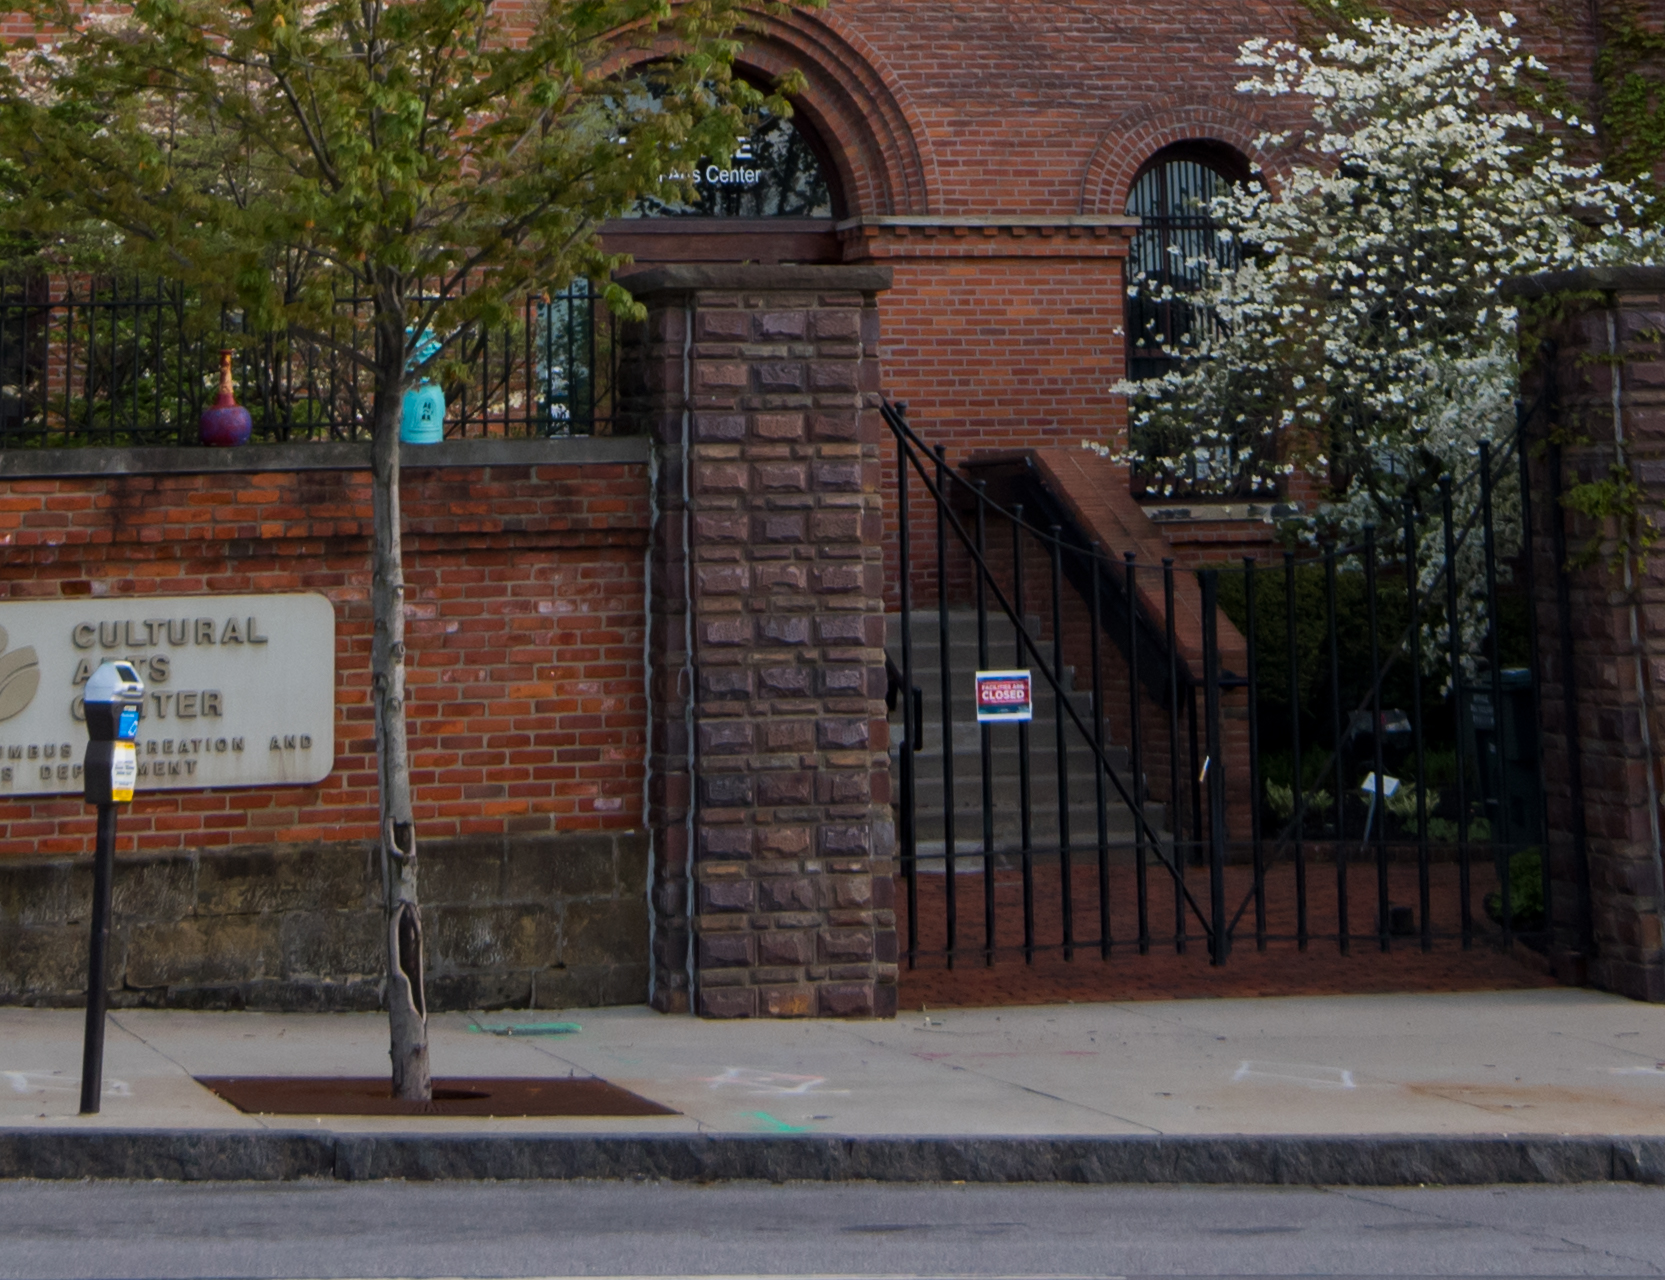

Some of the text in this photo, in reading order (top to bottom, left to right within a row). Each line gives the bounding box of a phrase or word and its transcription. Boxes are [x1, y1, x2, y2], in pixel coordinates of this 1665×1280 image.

[706, 165, 761, 183] Center
[72, 617, 268, 648] CULTURAL
[982, 690, 1024, 700] CLOSED
[270, 733, 313, 751] AND
